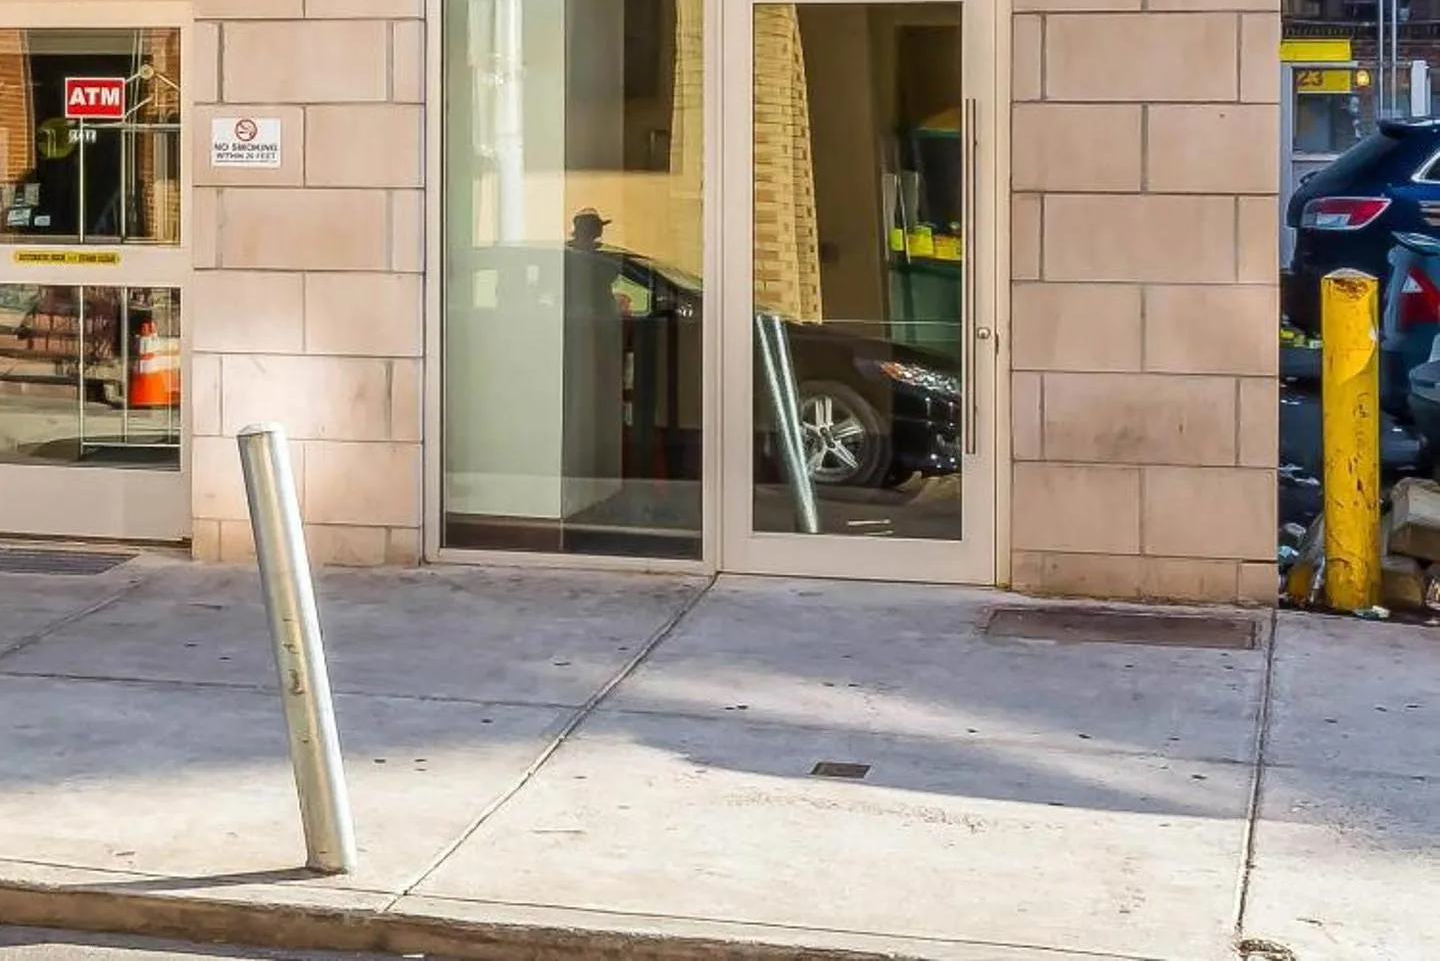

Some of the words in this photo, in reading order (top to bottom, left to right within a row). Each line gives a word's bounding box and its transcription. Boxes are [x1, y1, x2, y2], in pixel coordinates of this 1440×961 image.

[68, 86, 121, 106] ATM
[214, 142, 230, 152] NO
[231, 142, 278, 152] SMOKING
